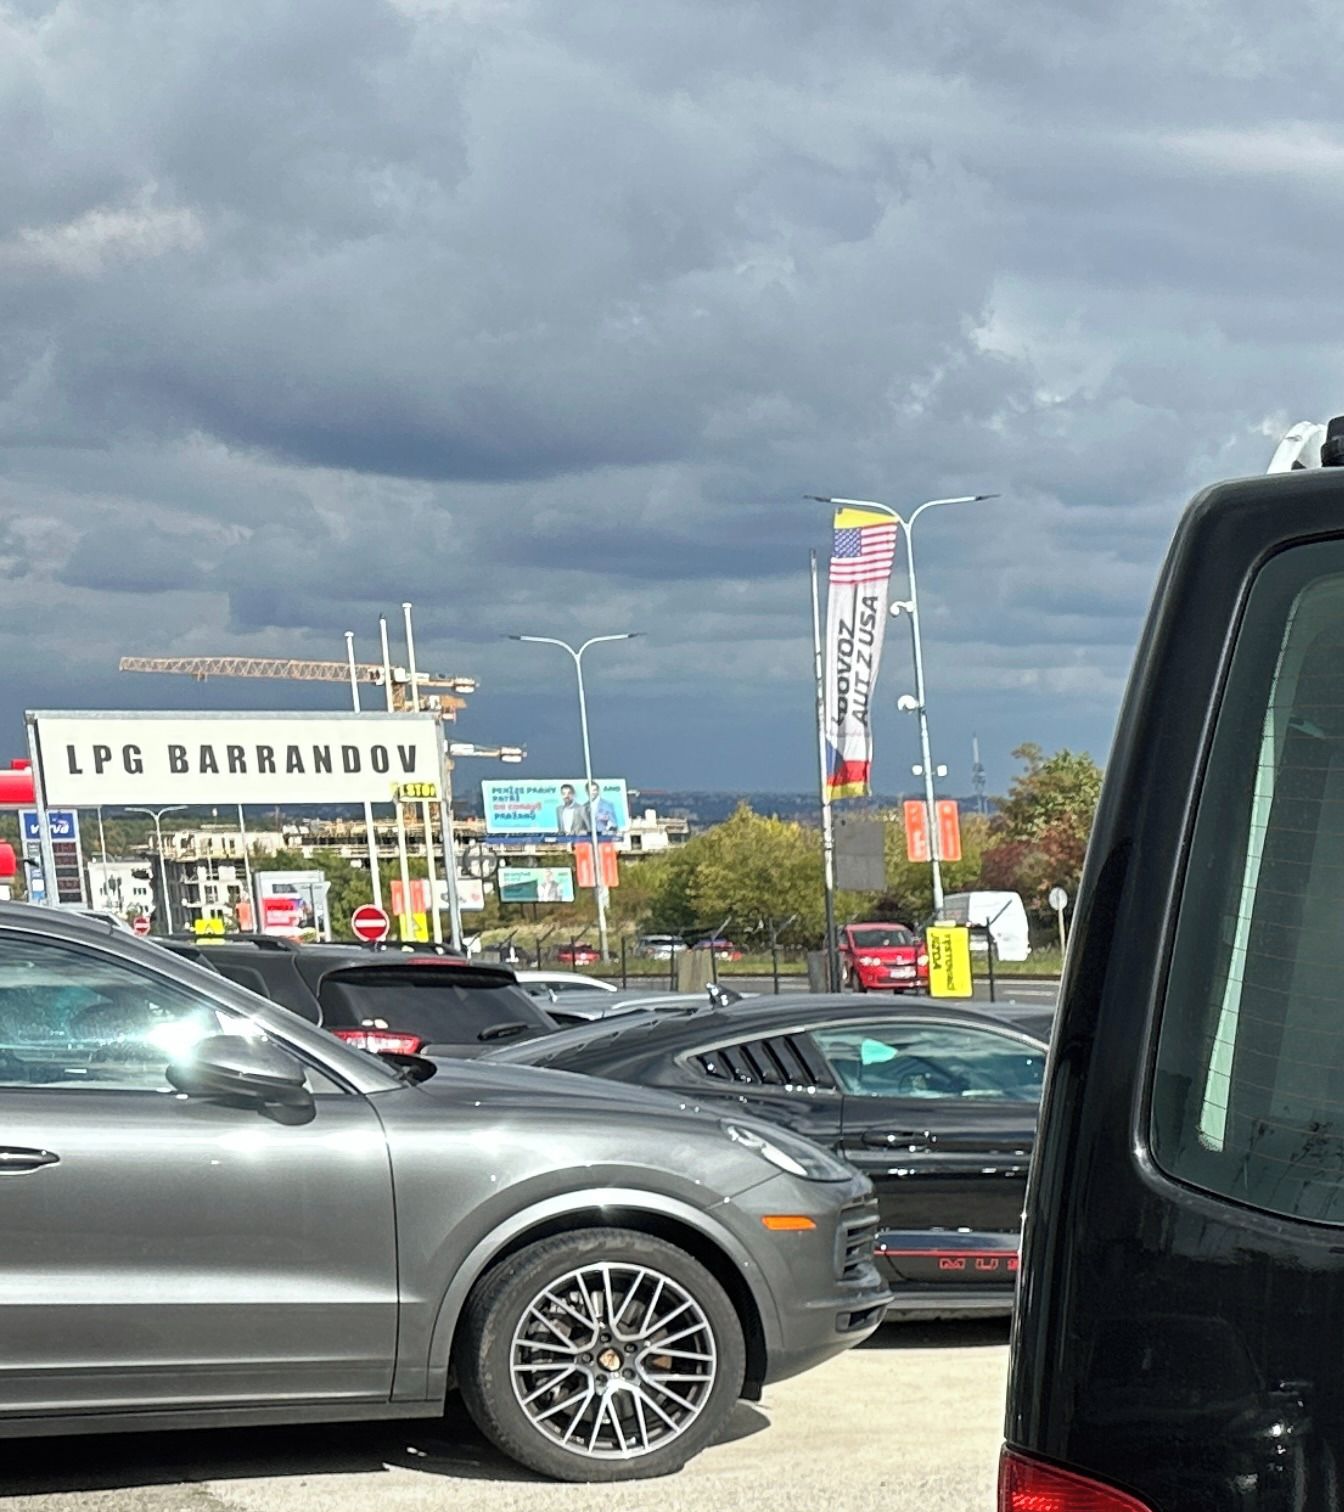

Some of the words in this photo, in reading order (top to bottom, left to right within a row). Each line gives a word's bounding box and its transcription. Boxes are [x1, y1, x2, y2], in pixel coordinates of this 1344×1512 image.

[858, 596, 879, 646] USA
[857, 650, 872, 670] Z
[852, 671, 870, 727] AUT
[66, 744, 144, 775] LPG
[168, 744, 417, 775] BARRANDOV
[30, 823, 70, 834] vrva
